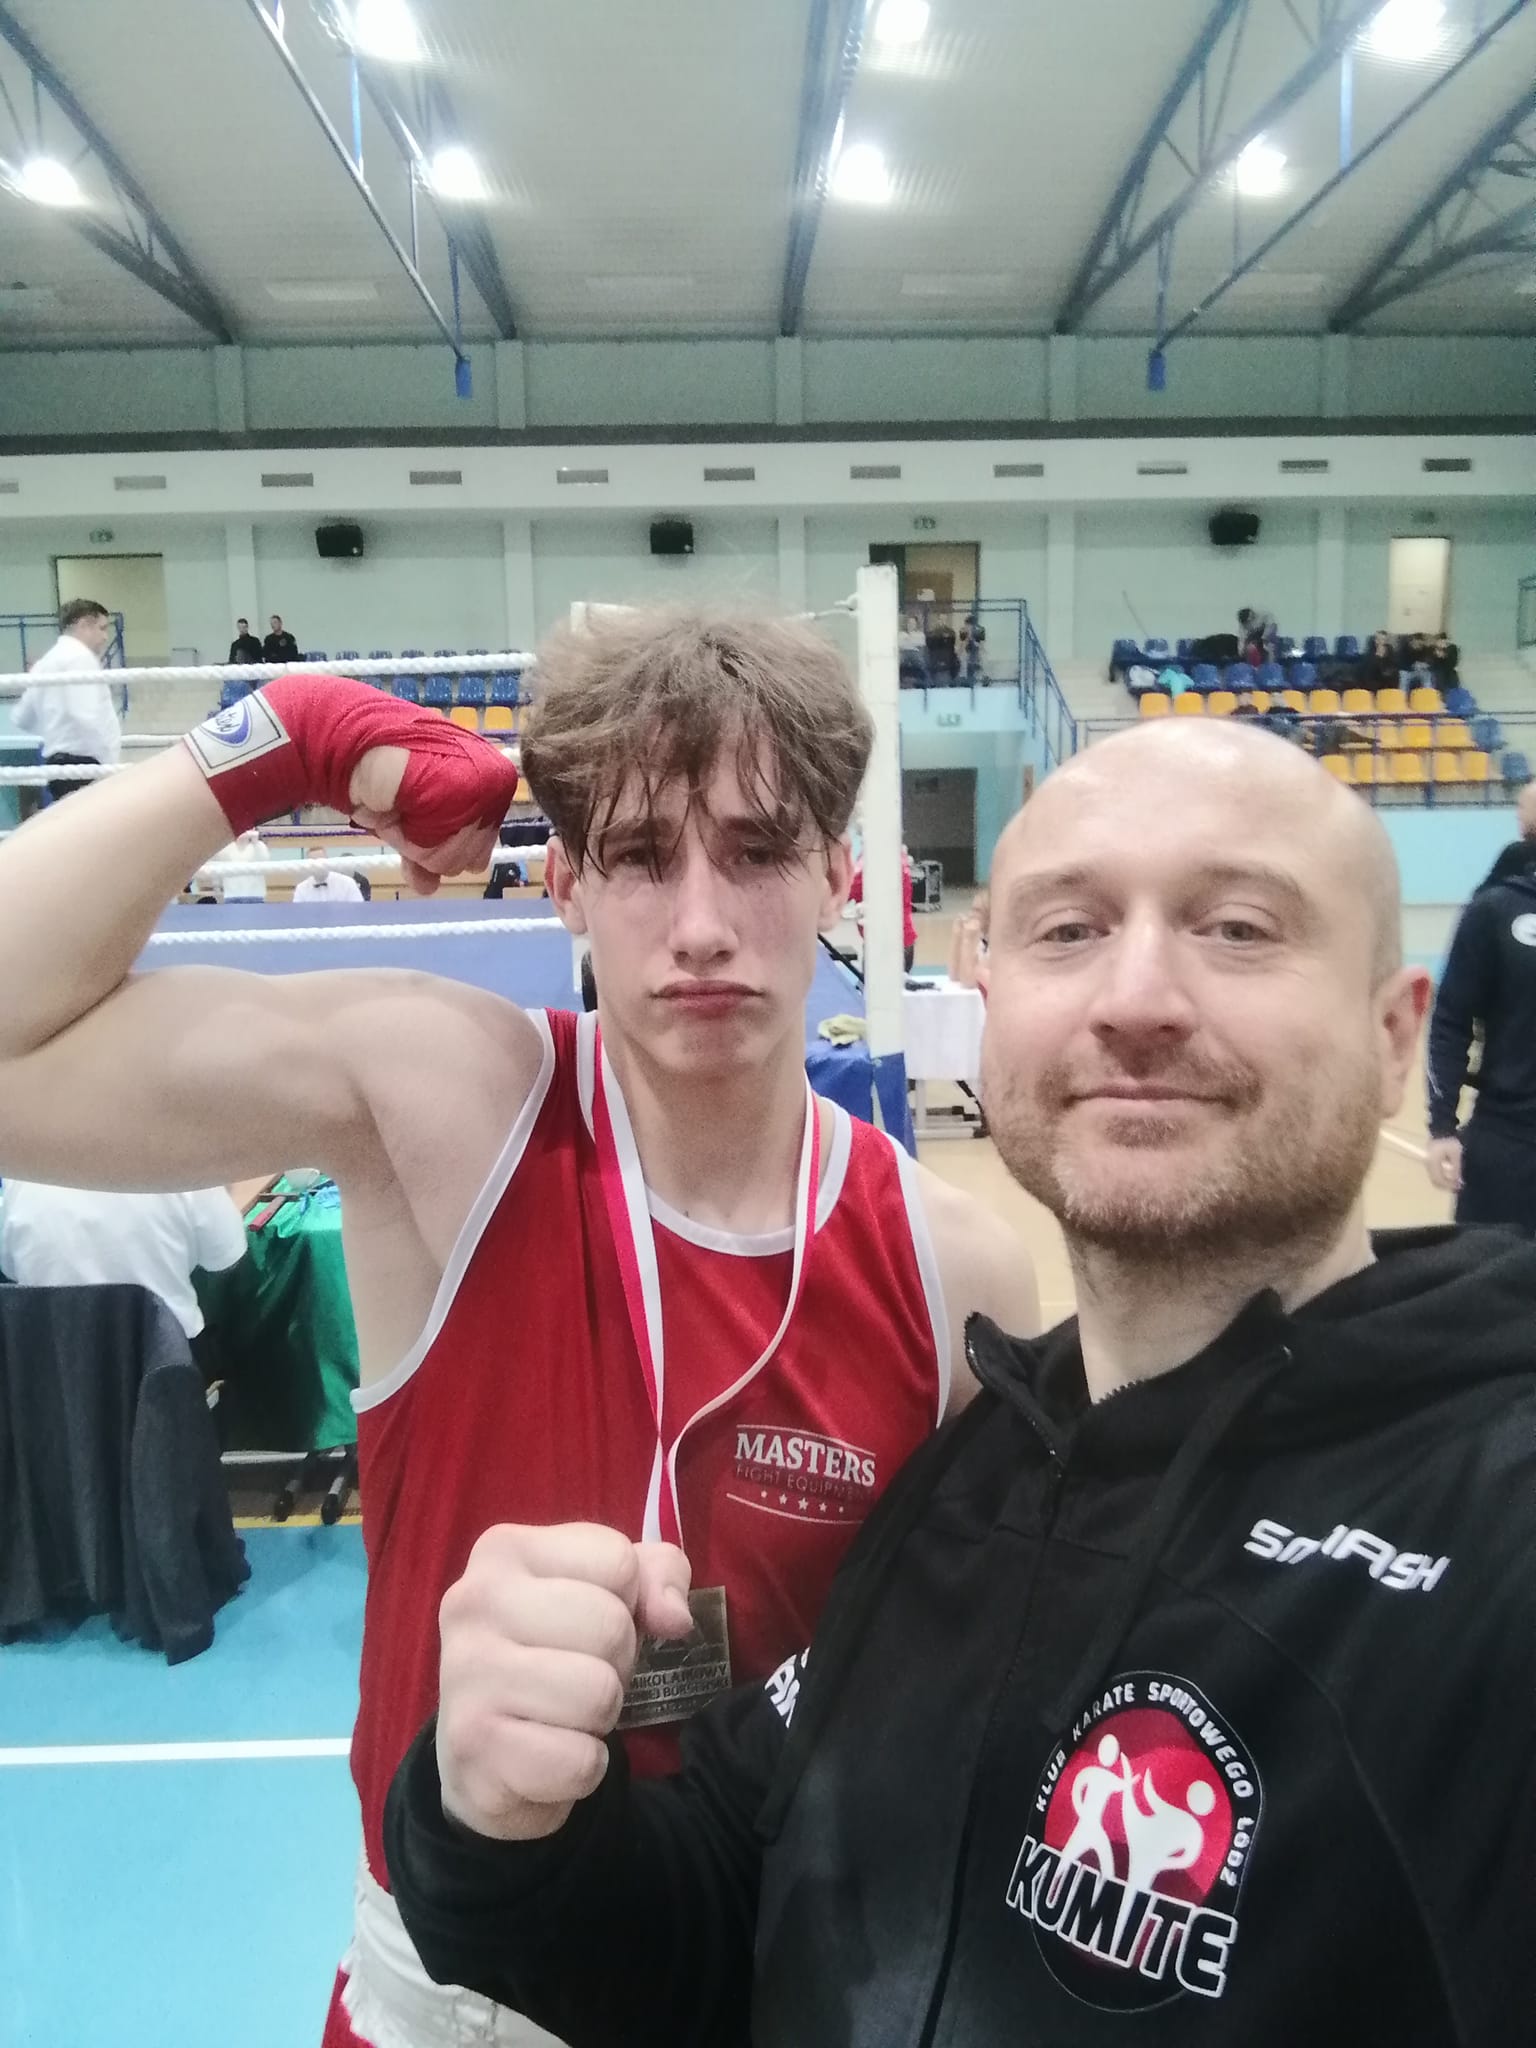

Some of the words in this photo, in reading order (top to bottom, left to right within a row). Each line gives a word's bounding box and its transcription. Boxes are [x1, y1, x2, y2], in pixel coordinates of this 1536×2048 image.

[734, 1432, 876, 1487] MASTERS
[1243, 1518, 1452, 1592] SMASH
[1036, 1749, 1067, 1812] KLUB
[1072, 1682, 1135, 1742] KARATE
[1148, 1681, 1254, 1799] SPORTOWEGO
[1006, 1834, 1239, 1998] KUMITE
